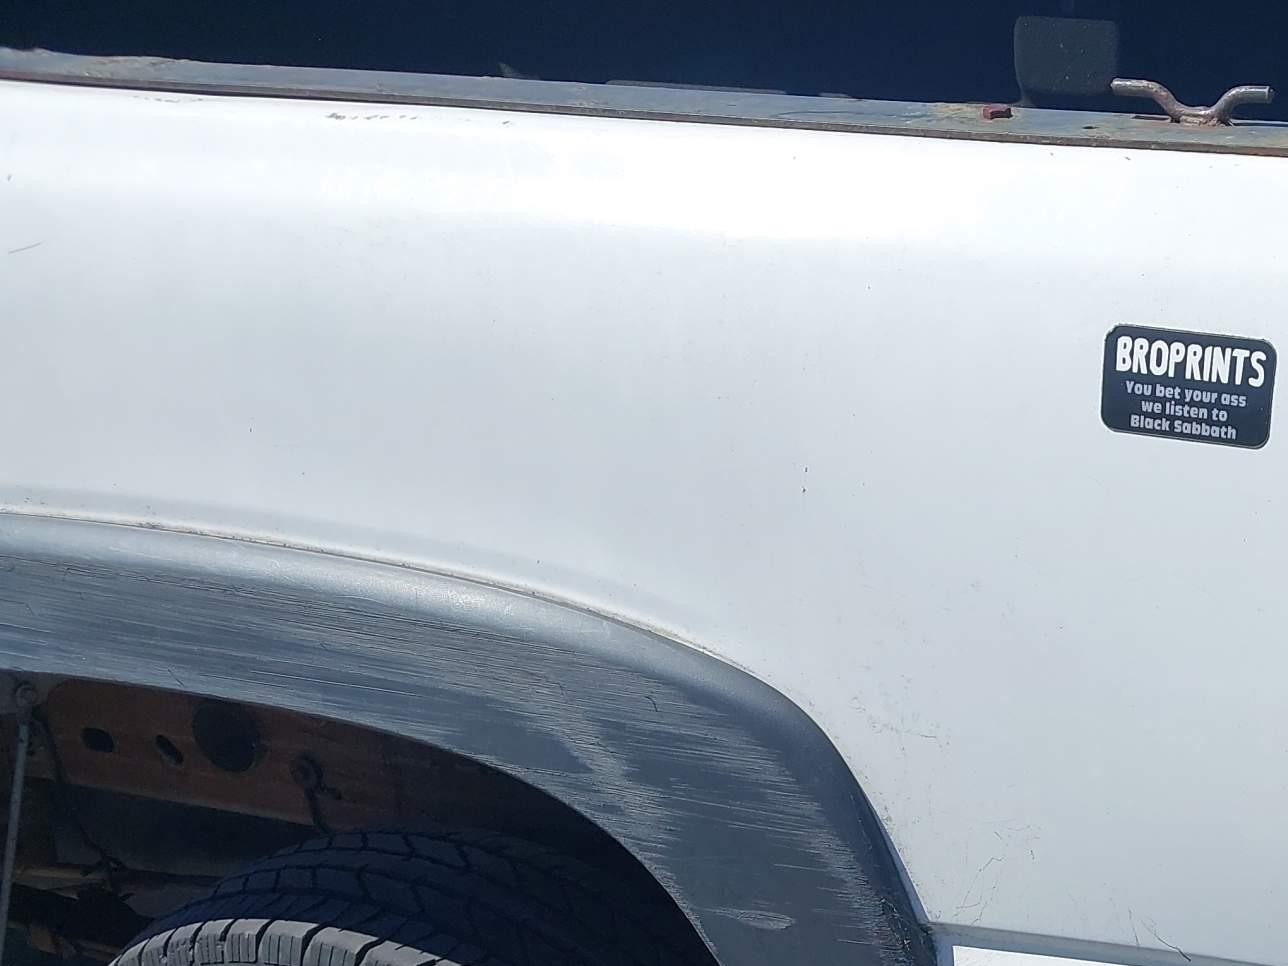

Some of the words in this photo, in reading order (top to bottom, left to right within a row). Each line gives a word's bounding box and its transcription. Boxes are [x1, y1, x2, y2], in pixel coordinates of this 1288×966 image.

[1115, 335, 1267, 388] BROPRINTS
[1125, 380, 1152, 396] You
[1155, 383, 1181, 399] bet
[1184, 388, 1218, 403] your
[1221, 393, 1247, 407] ass
[1141, 400, 1162, 413] we
[1165, 400, 1208, 419] listen
[1211, 408, 1228, 421] to
[1130, 414, 1171, 431] Black
[1174, 419, 1237, 440] Sabbath
